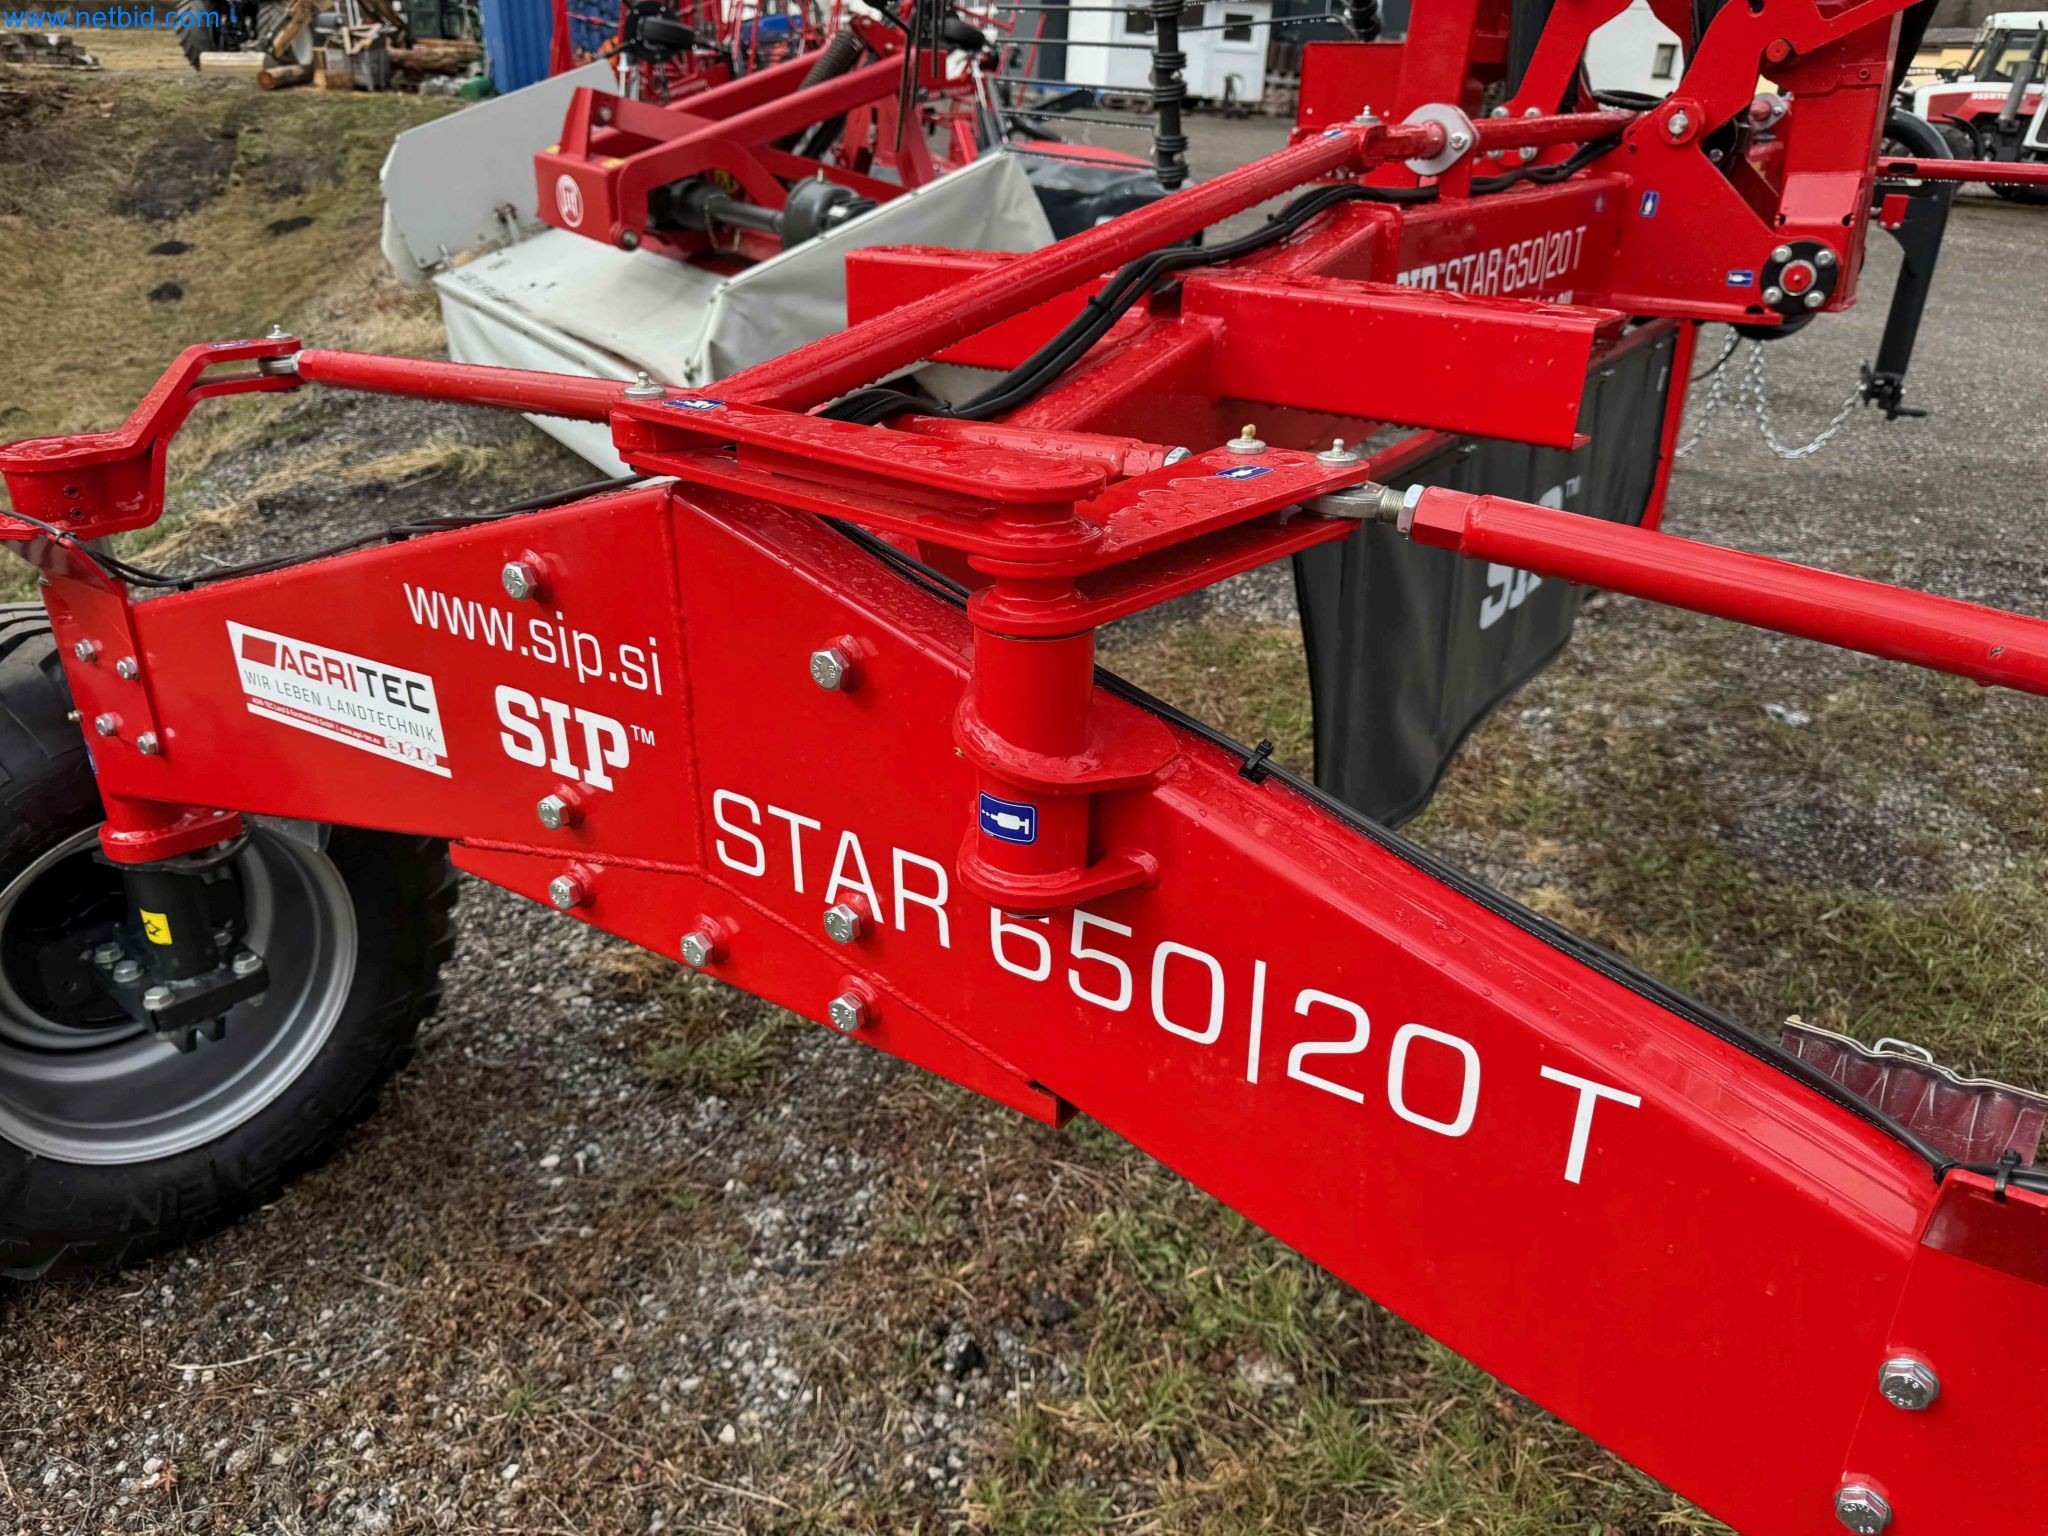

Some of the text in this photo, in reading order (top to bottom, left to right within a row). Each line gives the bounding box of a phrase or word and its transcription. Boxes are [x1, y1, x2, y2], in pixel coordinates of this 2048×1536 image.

[1445, 248, 1501, 296] STAR
[1573, 225, 1587, 270] T
[280, 643, 430, 714] AGRITEC
[403, 583, 662, 695] www.sip.si
[244, 669, 437, 743] WIR LEBEN LANDTECHNIK
[495, 684, 630, 792] SIP
[713, 788, 950, 949] STAR
[1540, 1065, 1642, 1185] T
